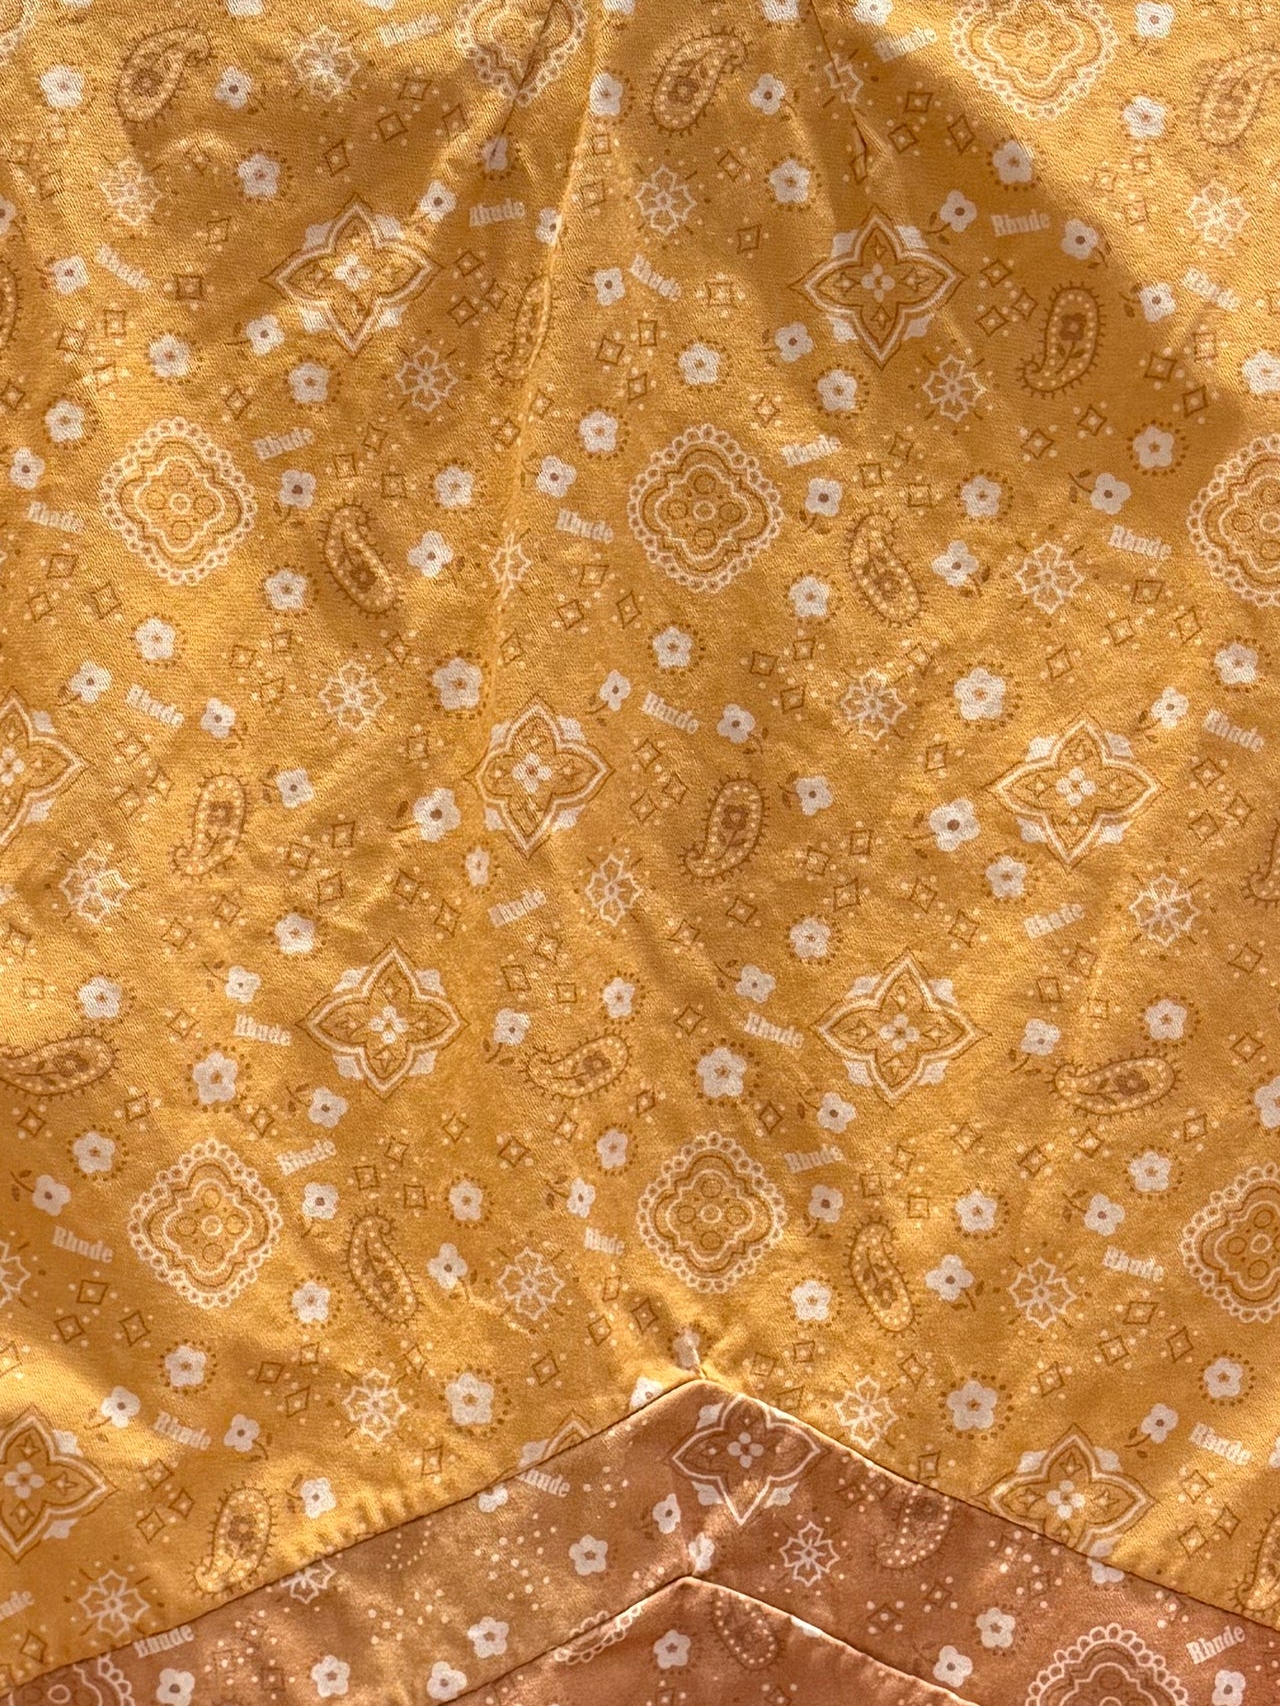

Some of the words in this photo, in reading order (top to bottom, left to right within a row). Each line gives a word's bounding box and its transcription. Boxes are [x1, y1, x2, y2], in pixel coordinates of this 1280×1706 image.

[991, 209, 1051, 237] Rhude
[1190, 1420, 1250, 1466] Rhude
[1187, 1624, 1247, 1666] Rhude
